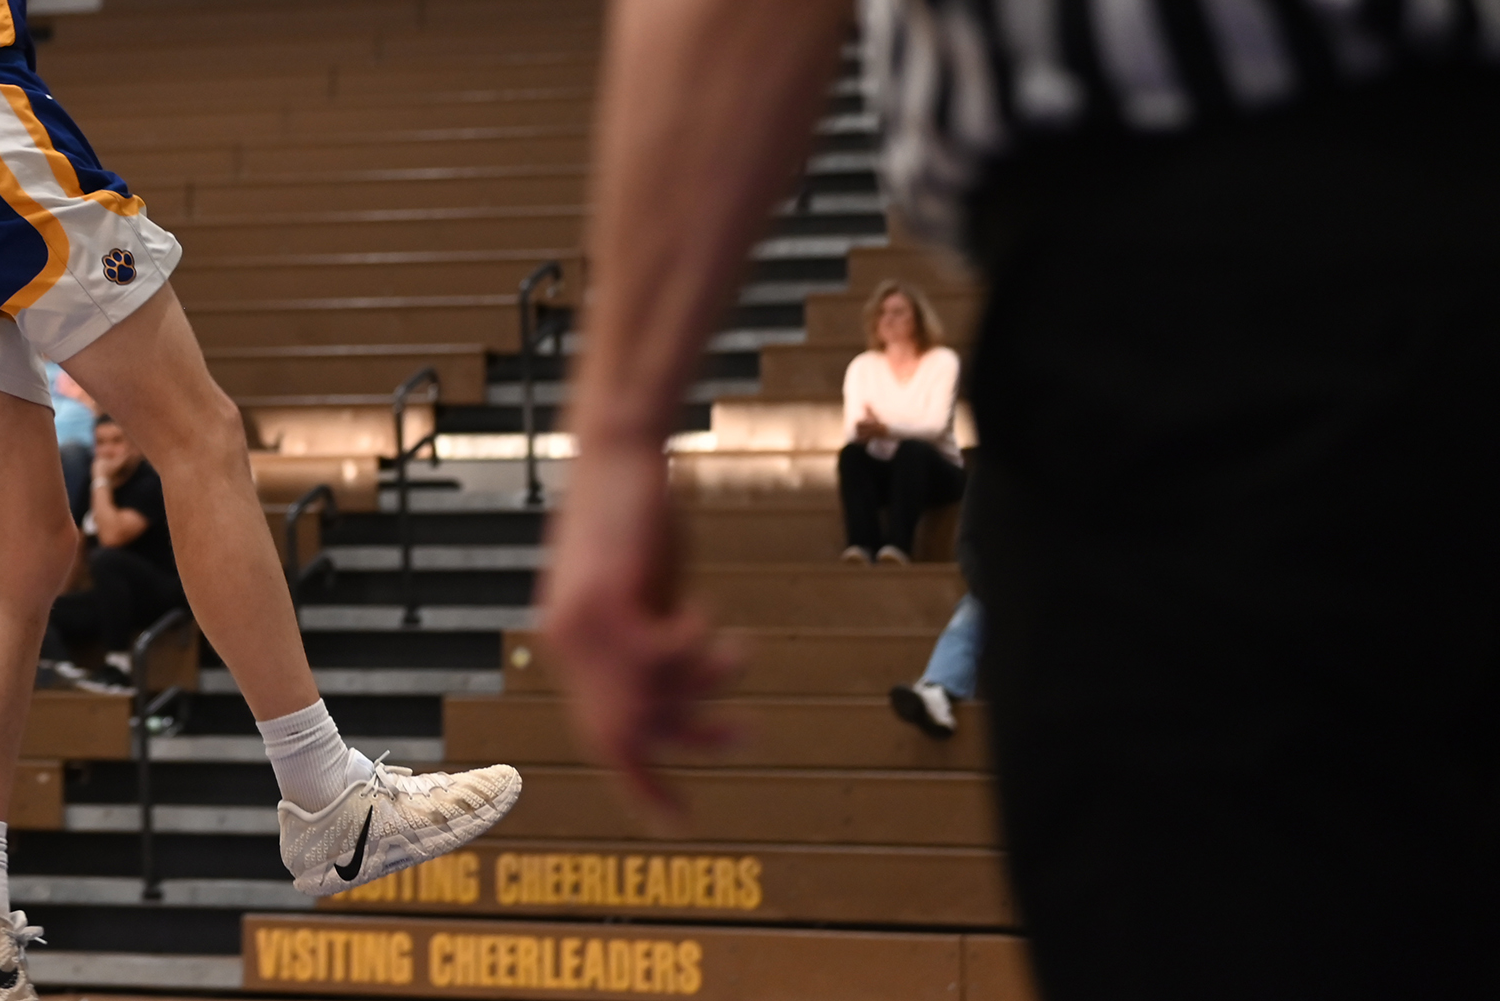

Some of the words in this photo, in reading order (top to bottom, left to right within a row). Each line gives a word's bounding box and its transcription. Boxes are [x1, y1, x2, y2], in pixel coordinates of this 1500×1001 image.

[496, 853, 762, 909] CHEERLEADERS
[255, 927, 414, 985] VISITING
[428, 933, 703, 994] CHEERLEADERS
